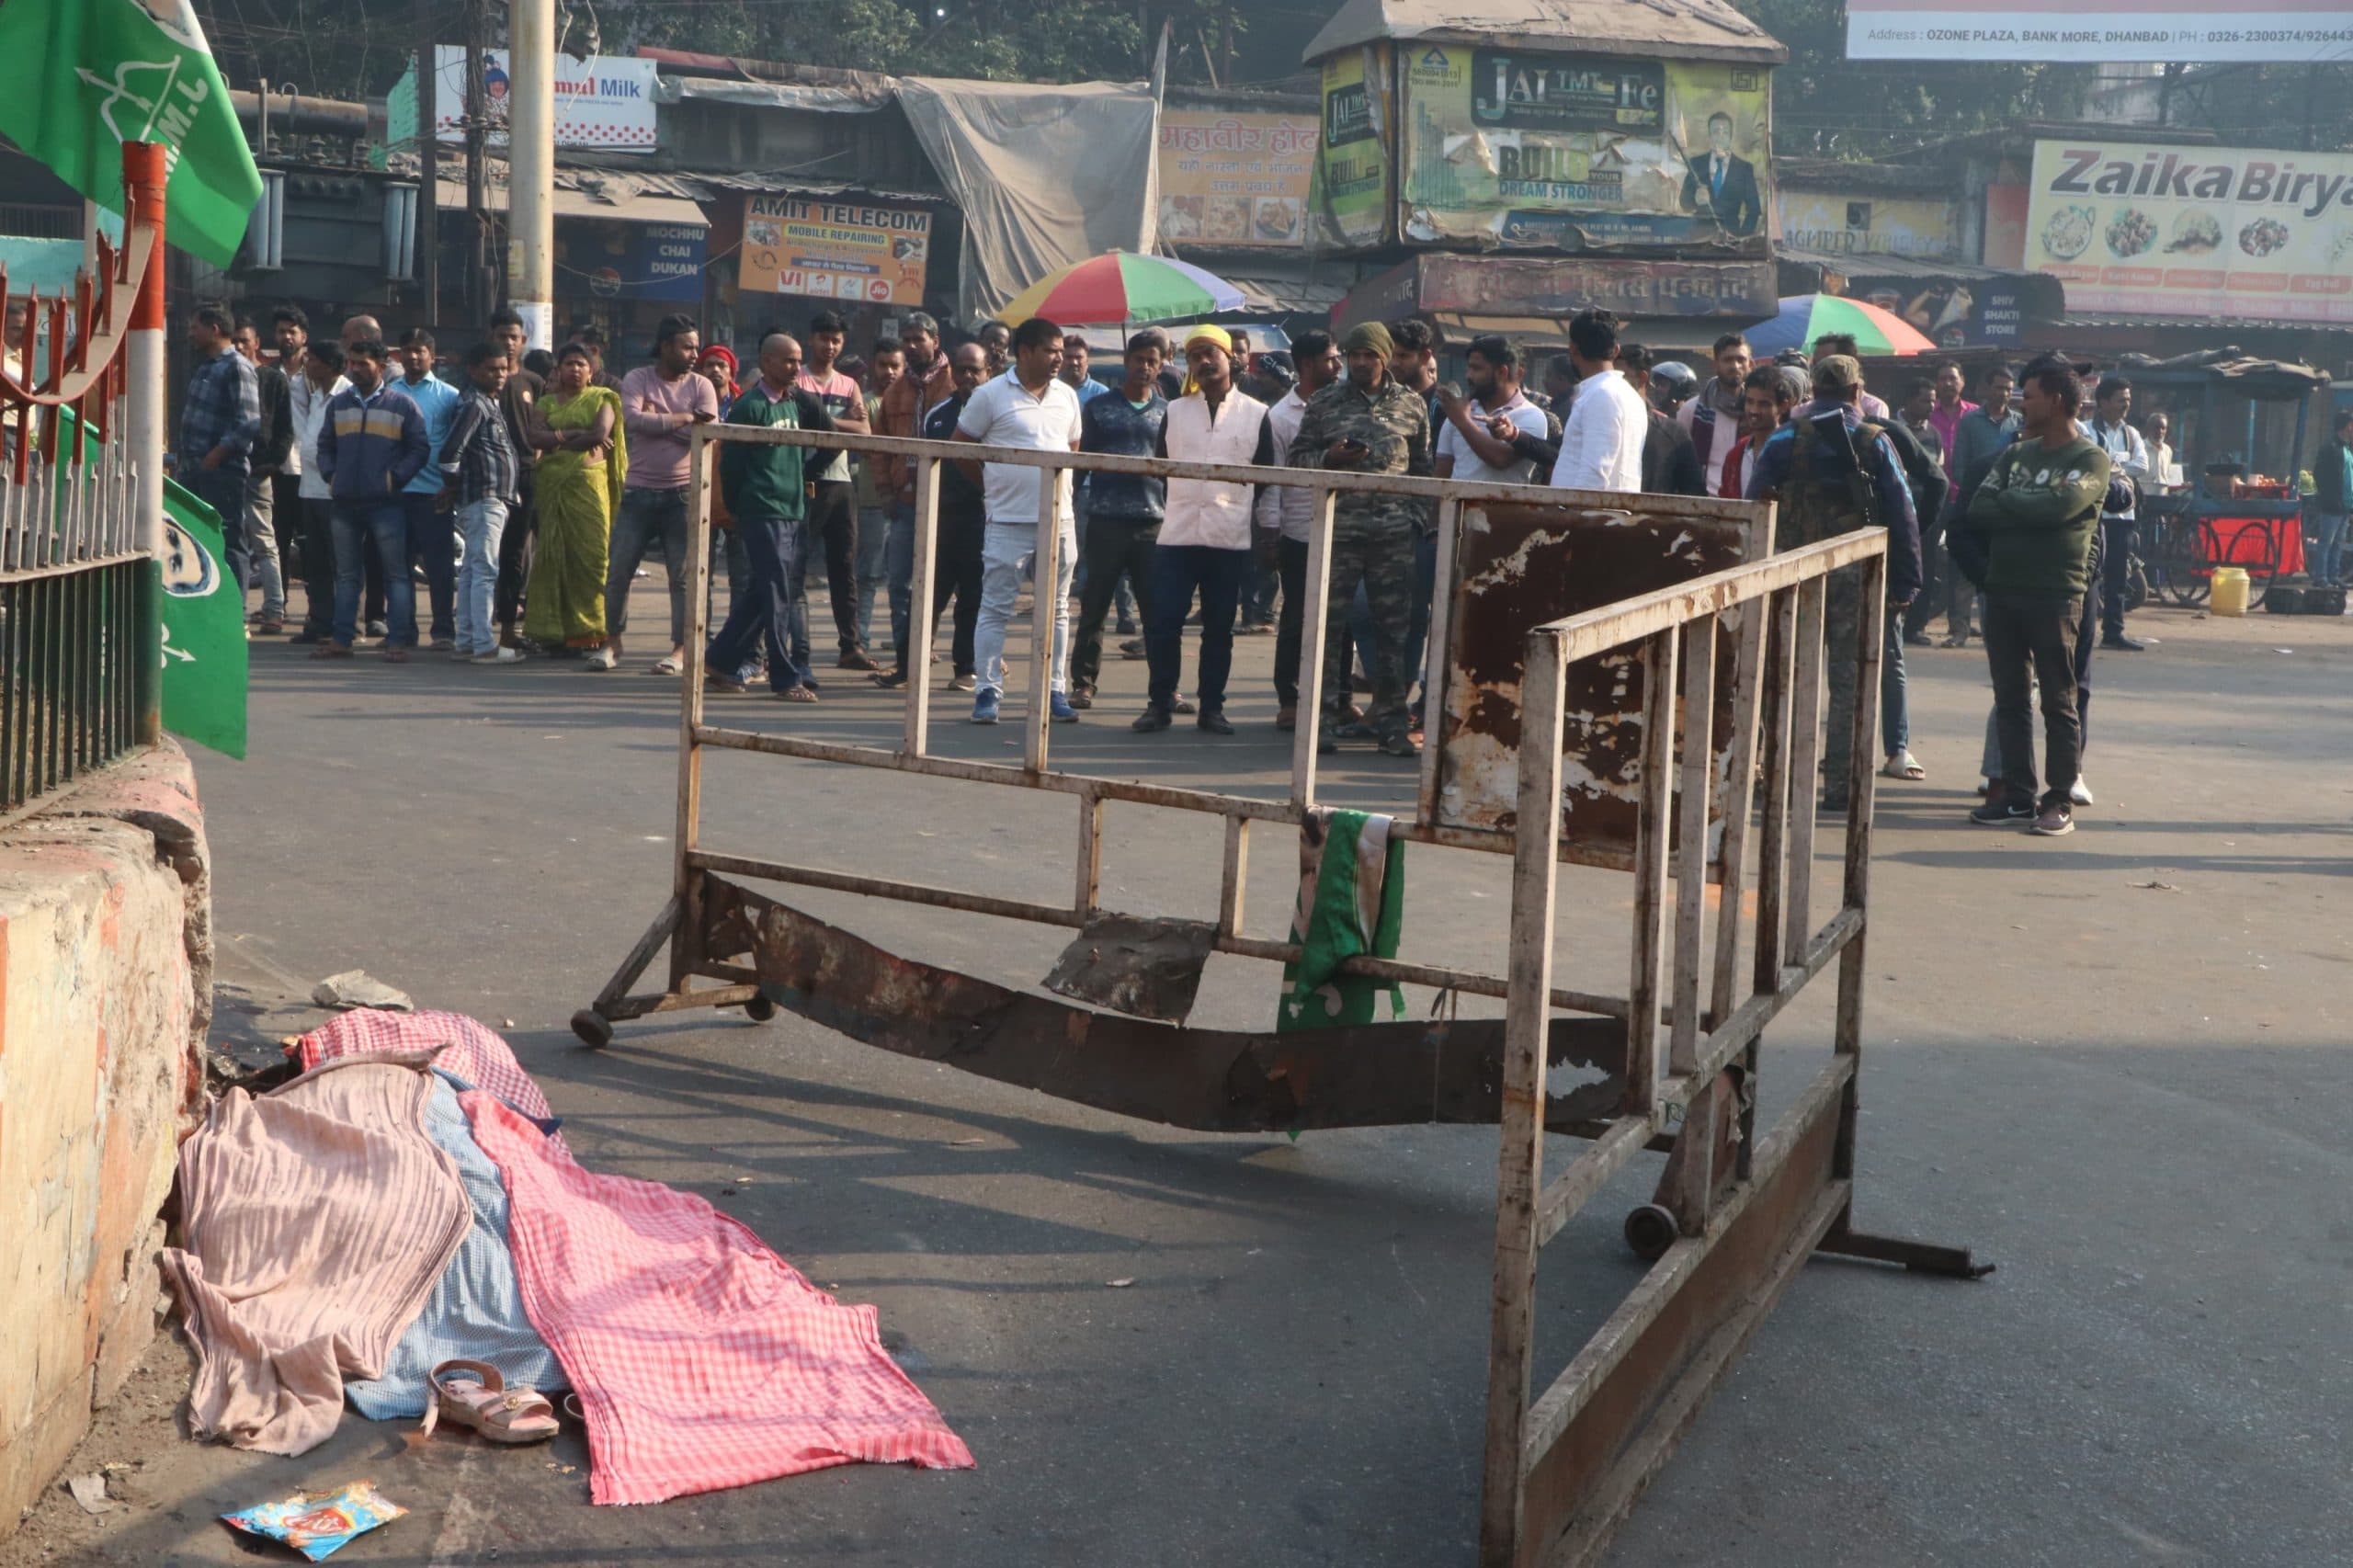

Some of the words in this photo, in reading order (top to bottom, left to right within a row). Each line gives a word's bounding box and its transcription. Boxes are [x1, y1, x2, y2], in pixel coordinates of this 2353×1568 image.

[1868, 29, 1916, 41] Address
[1927, 29, 1971, 41] OZONE
[1973, 30, 2018, 44] PLAZA,
[2022, 30, 2058, 42] BANK
[2062, 31, 2102, 44] MORE,
[2105, 31, 2169, 42] DHANBAD
[553, 76, 596, 96] mul
[600, 78, 641, 98] Milk
[1476, 57, 1550, 120] JAI
[1159, 119, 1262, 152] महावीर
[2051, 149, 2234, 199] Zaika
[1498, 183, 1548, 199] DREAM
[1551, 184, 1623, 201] STRONGER
[749, 197, 812, 219] AMIT
[820, 204, 927, 232] TELECOM
[788, 224, 827, 239] MOBILE
[830, 230, 885, 245] REPAIRING
[659, 244, 690, 258] CHAI
[651, 262, 699, 276] DUKAN
[870, 284, 887, 295] Jio
[1991, 295, 2016, 306] SHIV
[1984, 310, 2020, 321] SHAKTI
[1984, 324, 2017, 335] STORE
